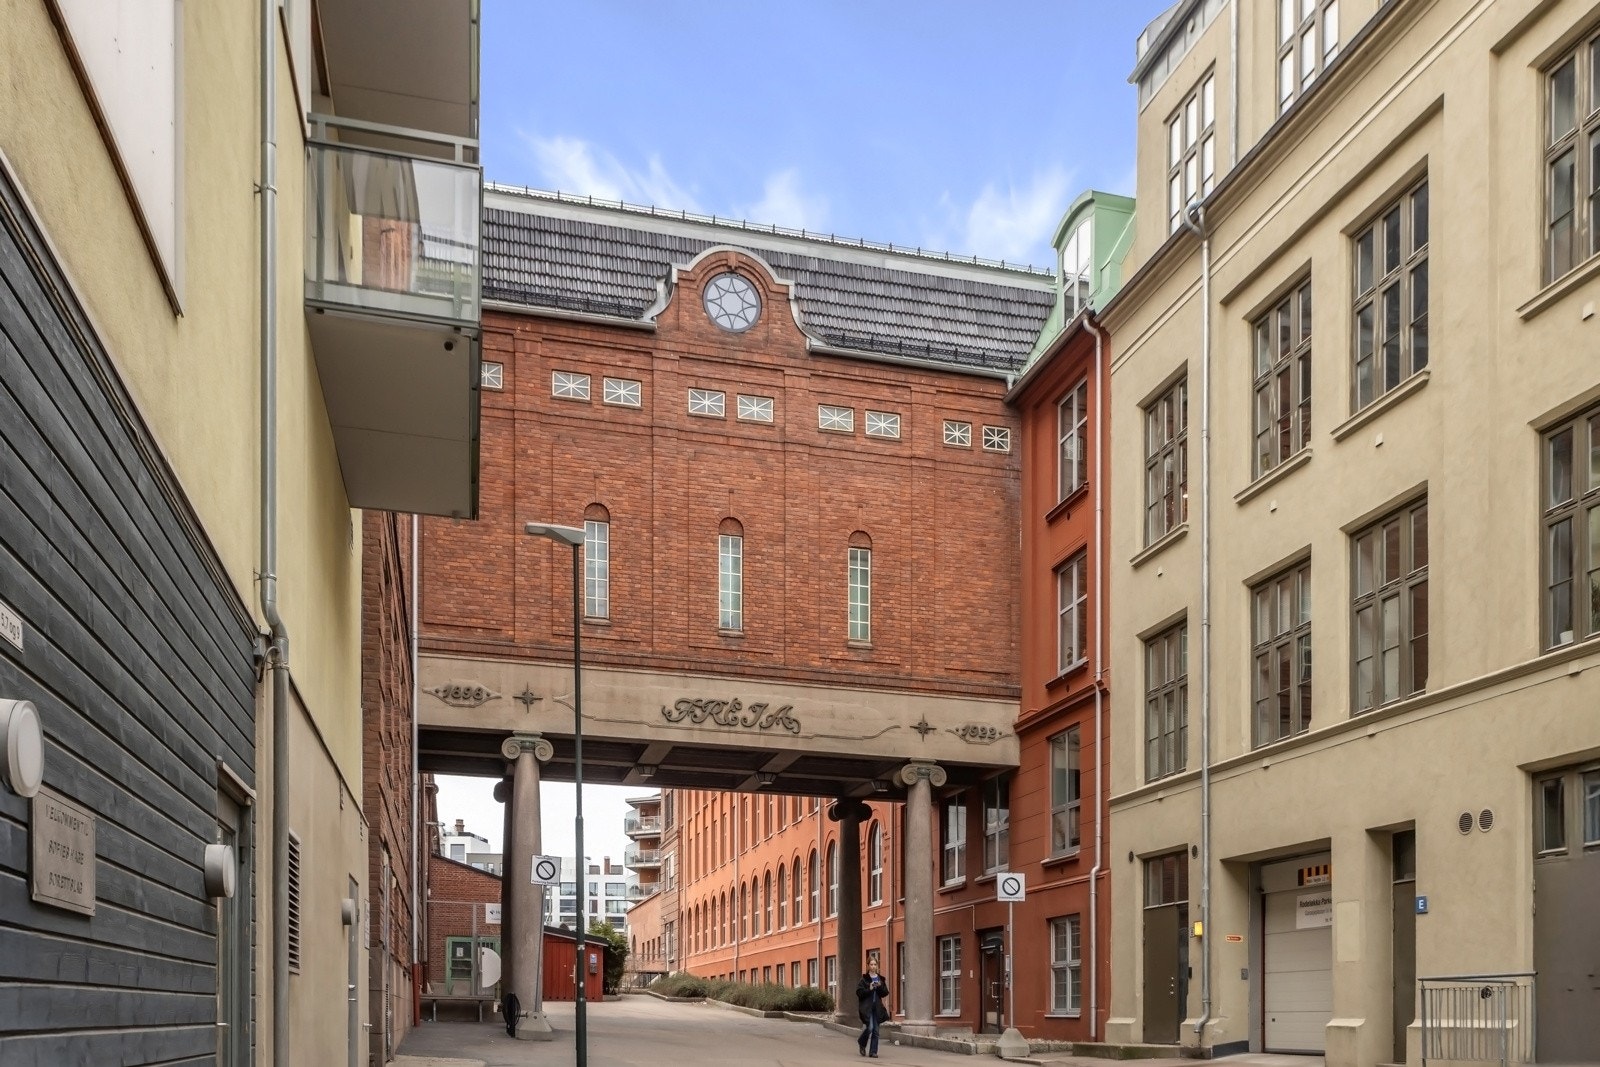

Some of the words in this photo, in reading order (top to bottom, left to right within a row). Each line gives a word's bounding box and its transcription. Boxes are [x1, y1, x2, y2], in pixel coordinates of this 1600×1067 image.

[442, 684, 483, 700] 1898
[961, 725, 997, 740] 1922
[1418, 899, 1424, 909] E
